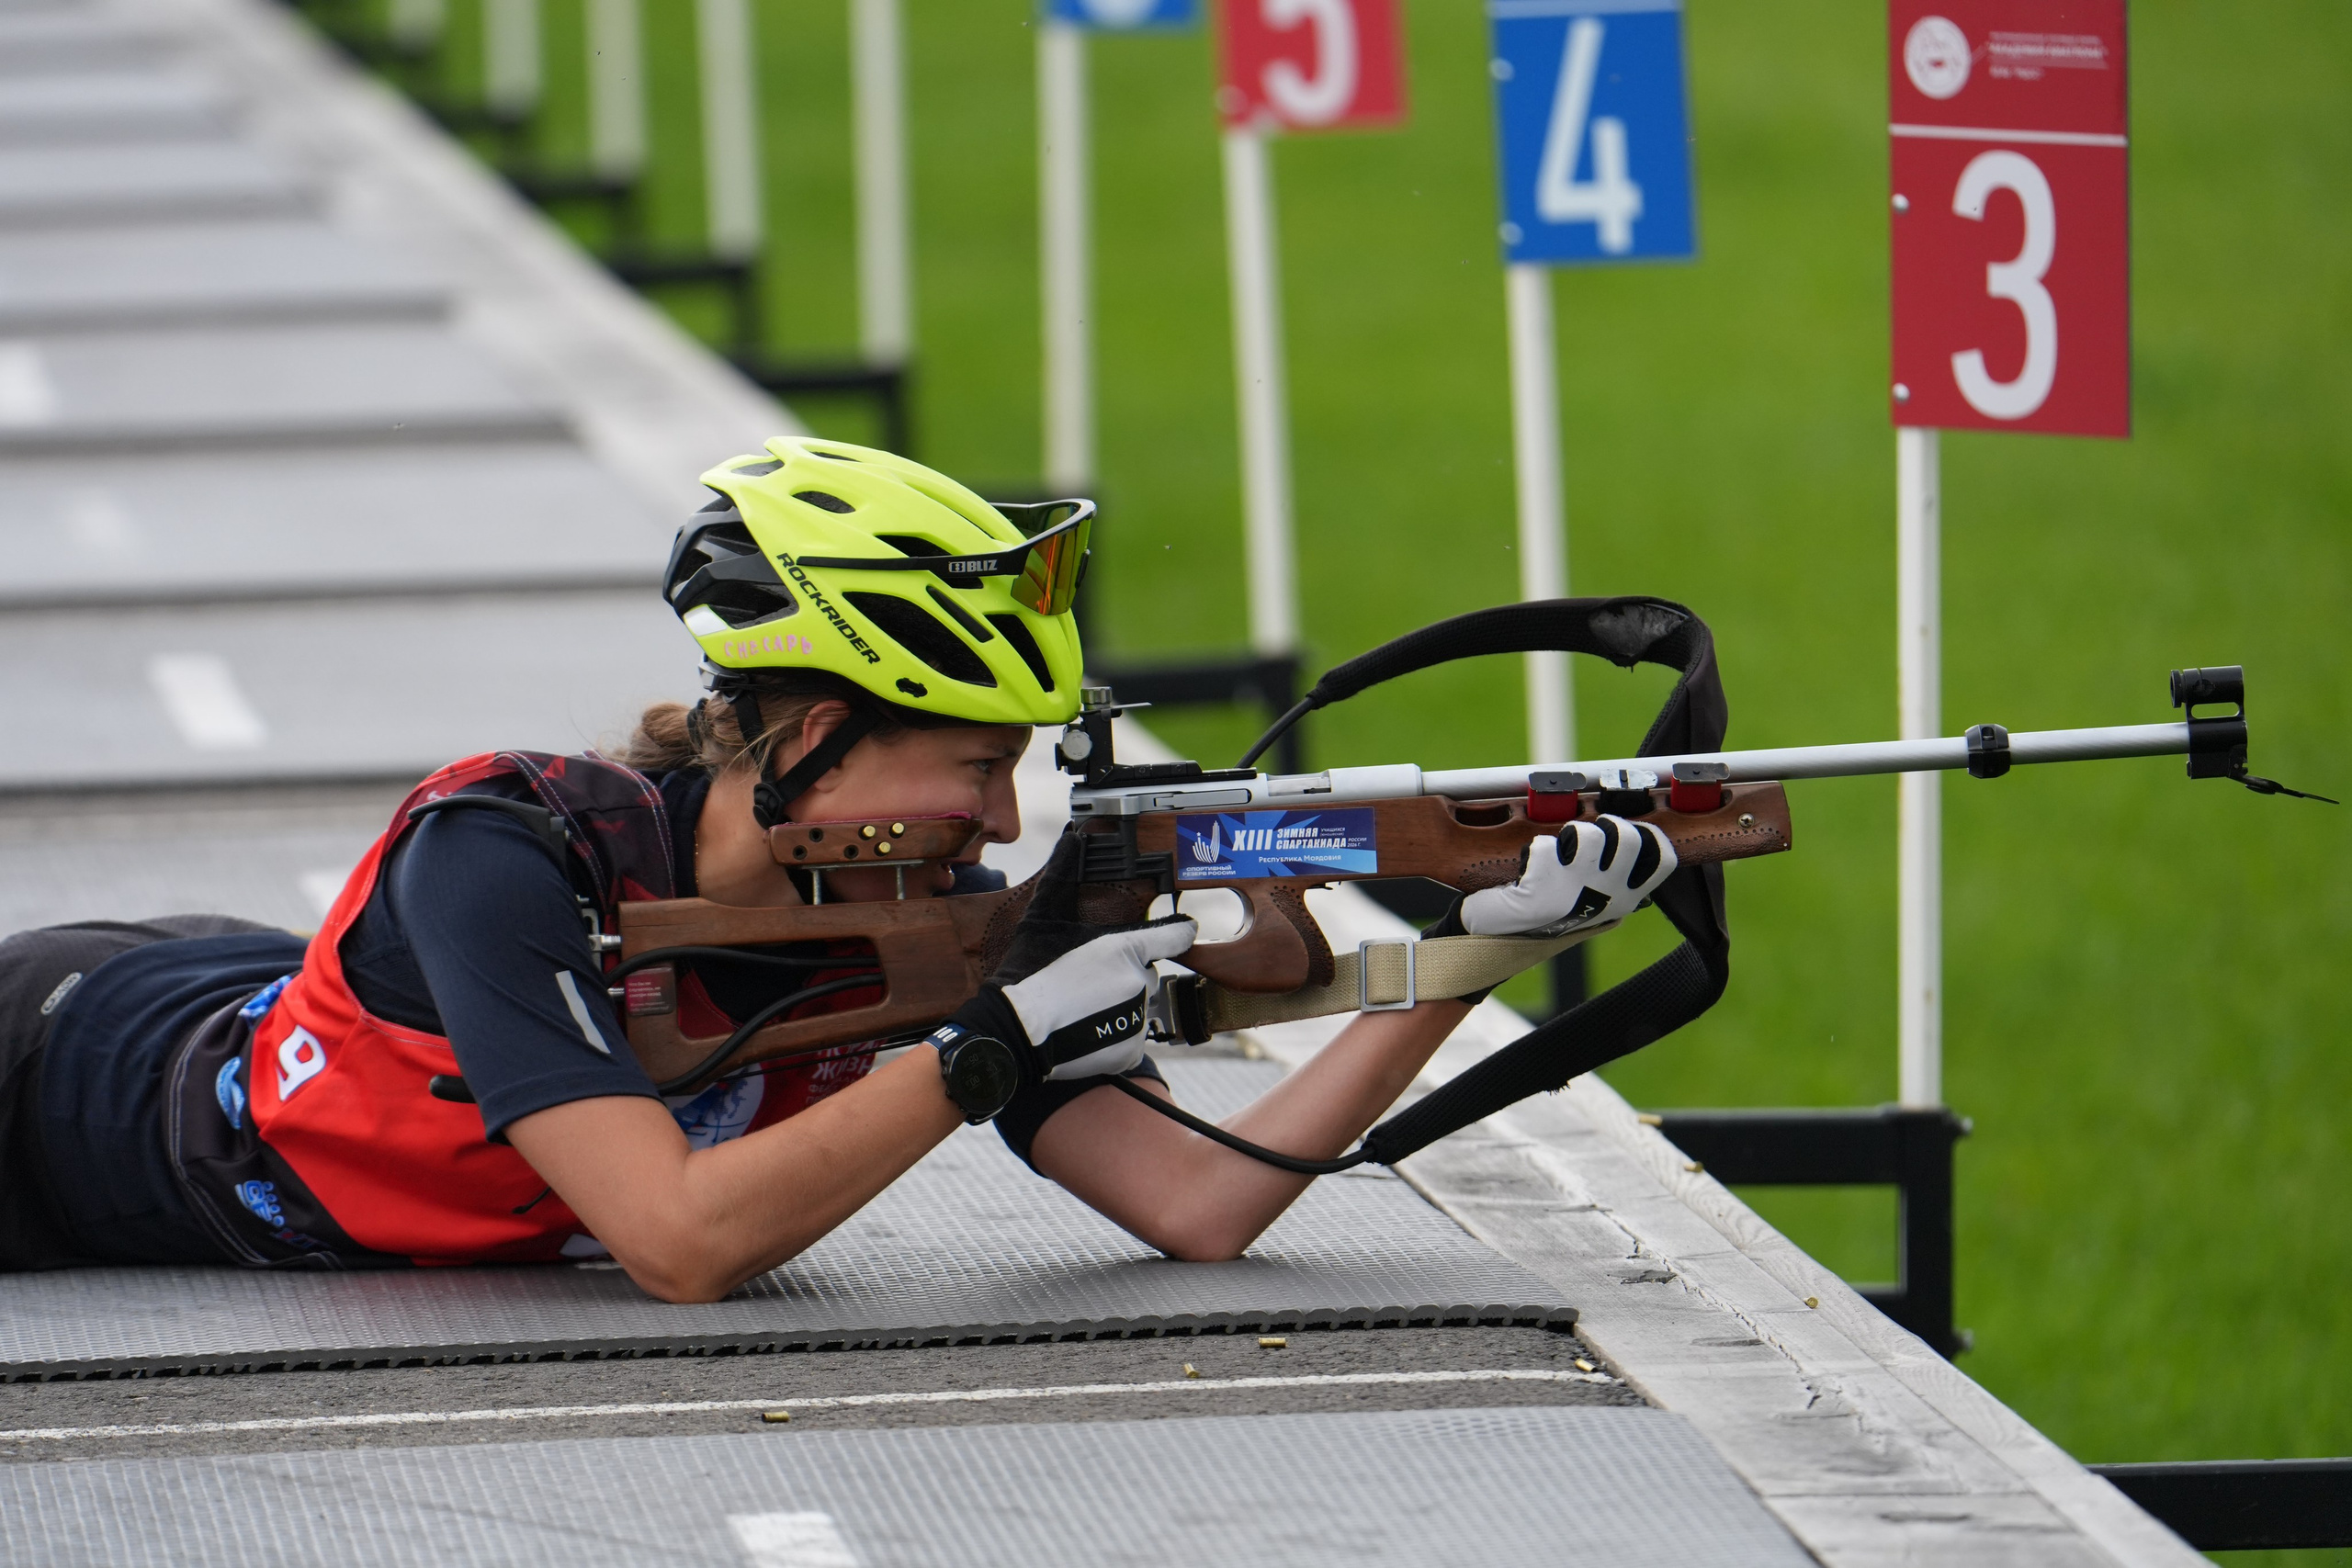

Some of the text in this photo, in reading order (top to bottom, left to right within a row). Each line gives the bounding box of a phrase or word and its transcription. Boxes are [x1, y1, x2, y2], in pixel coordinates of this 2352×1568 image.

[1532, 17, 1645, 255] 4
[1951, 149, 2058, 421] 3
[967, 559, 998, 572] BLIZ
[776, 552, 881, 664] ROCKRIDER
[725, 635, 812, 659] СНЕСАРЬ
[1232, 829, 1273, 852] XIII
[1275, 838, 1347, 850] СПАРТАКИАДА
[1276, 828, 1319, 839] ЗИМНЯЯ
